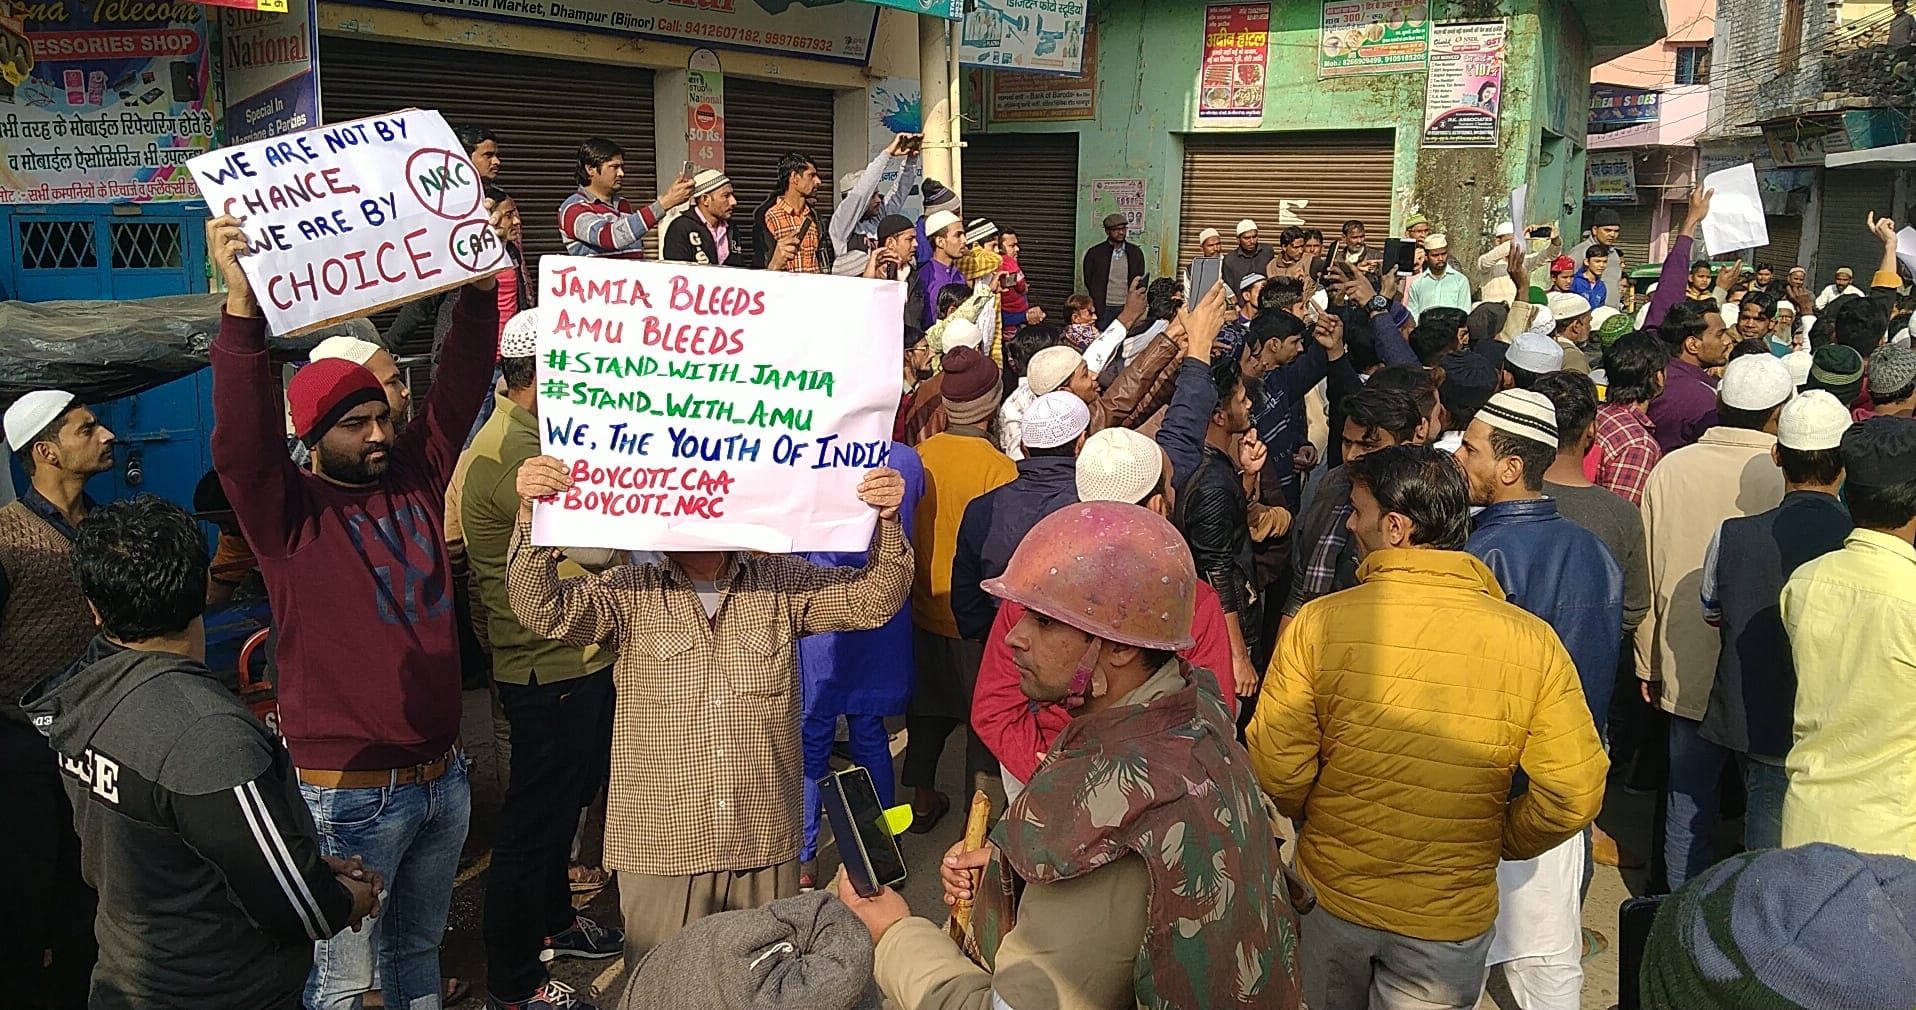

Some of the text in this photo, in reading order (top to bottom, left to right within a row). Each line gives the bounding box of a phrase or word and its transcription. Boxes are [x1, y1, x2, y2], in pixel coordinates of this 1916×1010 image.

[24, 1, 69, 21] na
[493, 0, 546, 17] Market,
[550, 5, 608, 25] Dhampur
[611, 12, 655, 30] (Bijnor)
[658, 18, 682, 34] Call:
[33, 35, 192, 55] ESSORIES SHOP
[227, 22, 308, 68] National
[1237, 27, 1267, 48] होटल
[245, 98, 284, 125] Special In
[1623, 93, 1657, 107] SHOES
[21, 119, 51, 140] तरह
[52, 114, 67, 136] के
[69, 113, 119, 138] मोबाईल
[178, 111, 201, 137] होते
[268, 123, 275, 137] &
[276, 112, 307, 133] Parties
[689, 128, 703, 140] 50
[8, 155, 19, 171] व
[20, 146, 73, 172] मोबाईल
[144, 142, 159, 166] भी
[202, 117, 408, 186] WE ARE NOT BY
[699, 145, 714, 160] 45
[28, 183, 50, 201] सभी
[97, 181, 108, 198] के
[418, 163, 471, 197] NRC
[246, 192, 398, 254] WE ARE BY
[456, 228, 497, 257] CAA
[267, 228, 443, 311] CHOICE
[551, 266, 766, 317] JAMIA BLEEDS
[552, 309, 745, 356] AMU BLEEDS
[543, 349, 835, 398] #STAND_WITH_JAMIA
[539, 378, 814, 432] #STAND_WITH_AMU
[546, 416, 597, 451] WE,
[609, 422, 654, 456] THE
[668, 427, 761, 463] YOUTH
[772, 434, 808, 468] OF
[560, 459, 735, 496] BOYCOTT_CAA
